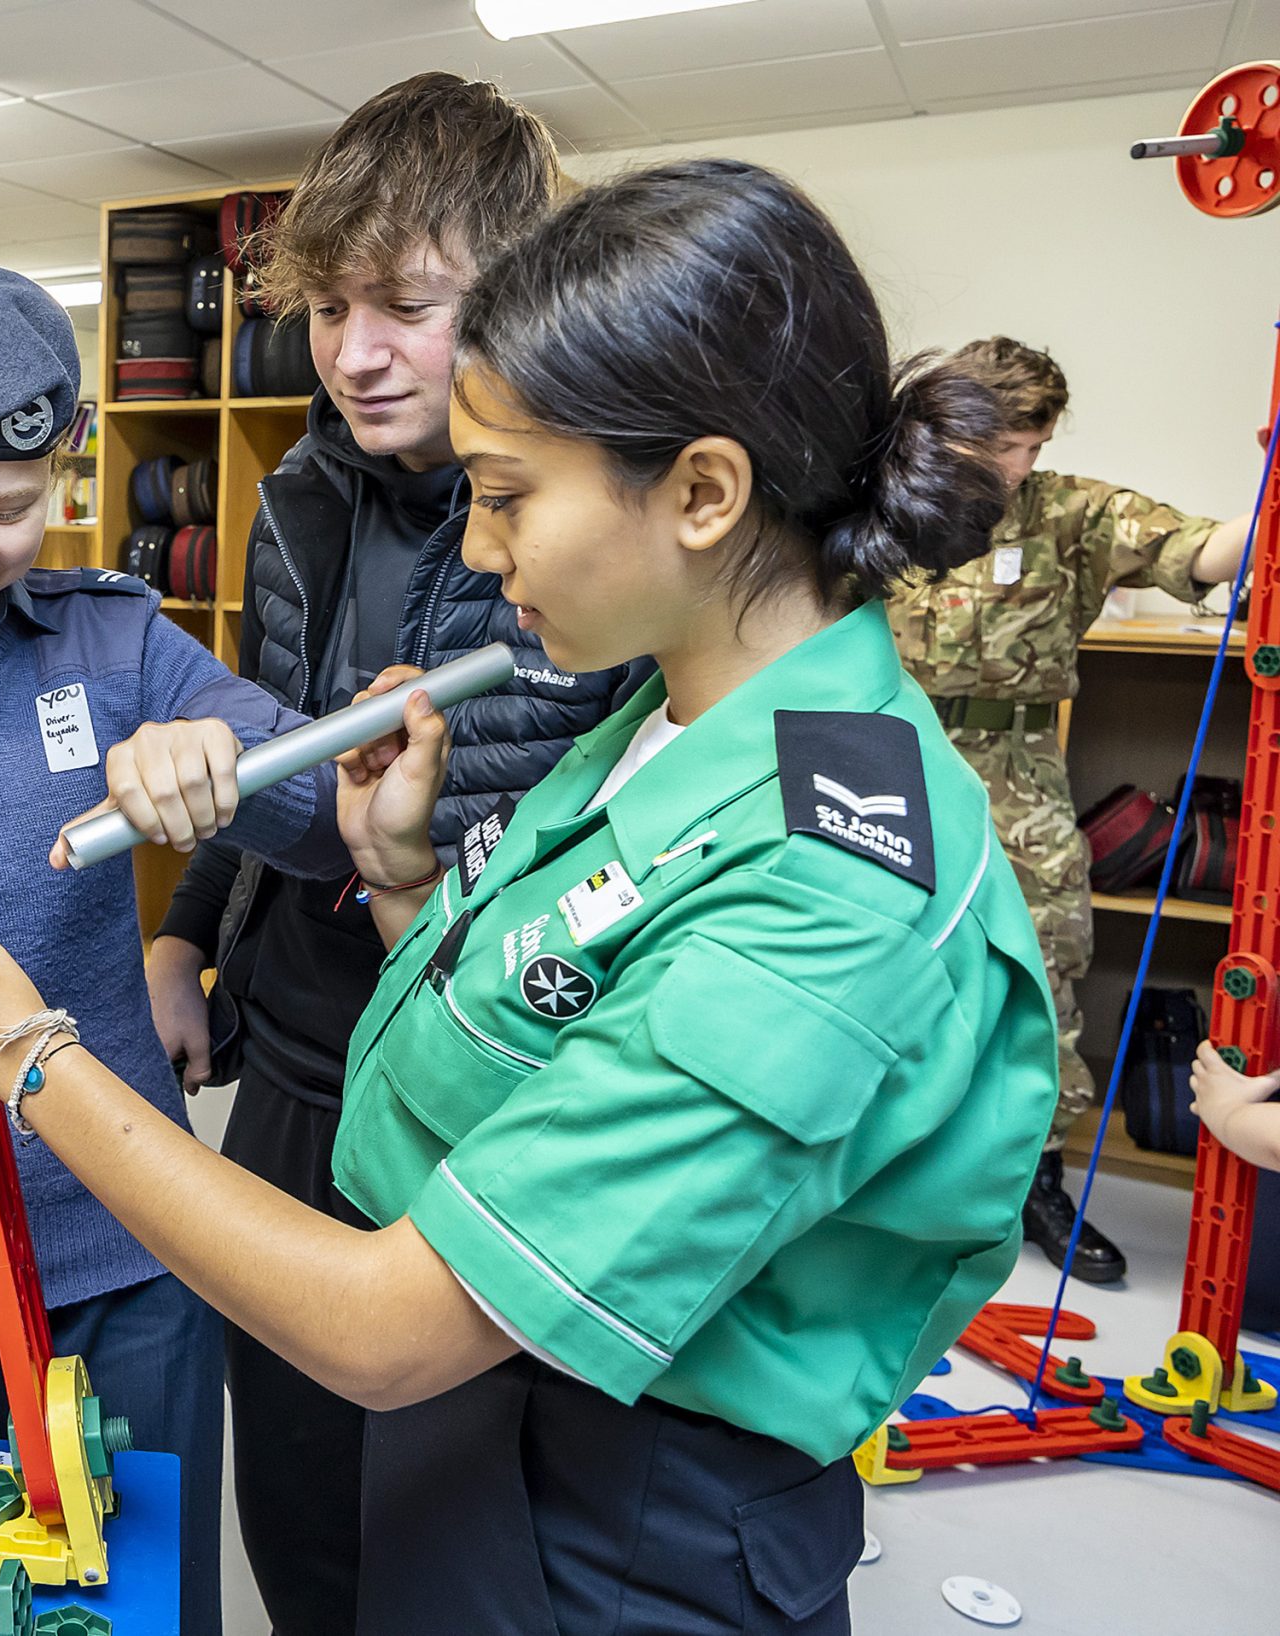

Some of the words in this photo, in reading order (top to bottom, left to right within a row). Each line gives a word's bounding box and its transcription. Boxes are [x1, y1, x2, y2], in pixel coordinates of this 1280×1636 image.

[513, 663, 576, 688] berghaus
[40, 686, 80, 709] YOU
[481, 812, 504, 852] CADET
[815, 804, 846, 827] St
[847, 816, 913, 855] John
[818, 819, 913, 868] Ambulance
